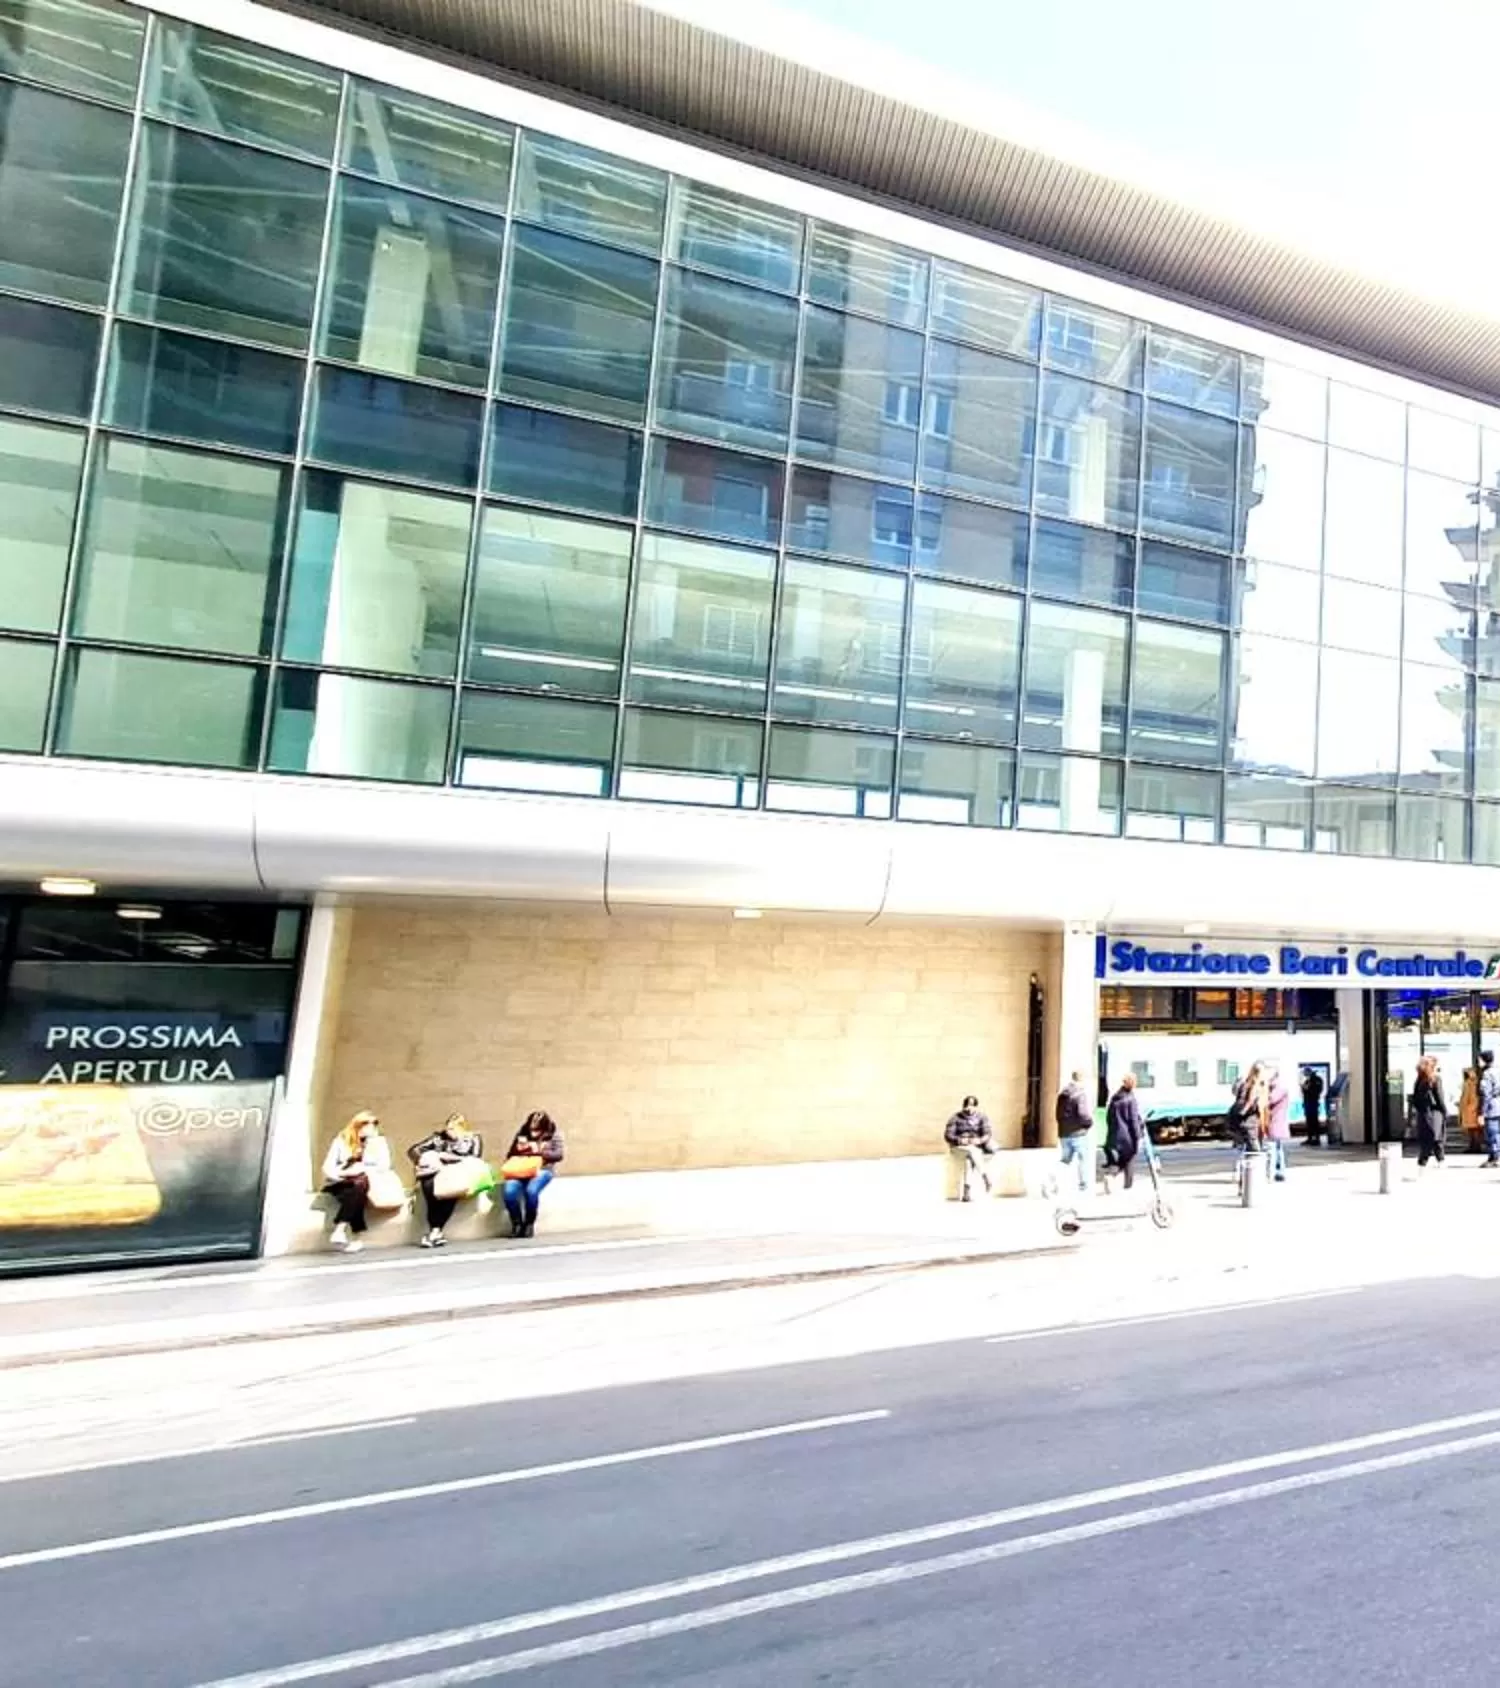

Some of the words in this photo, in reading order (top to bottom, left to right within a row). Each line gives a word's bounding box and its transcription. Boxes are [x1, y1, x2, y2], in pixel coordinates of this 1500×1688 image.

[1110, 941, 1271, 974] Stazione
[1279, 947, 1348, 975] Bari
[1357, 949, 1484, 977] Centrale
[46, 1025, 242, 1049] PROSSIMA
[39, 1059, 235, 1084] APERTURA
